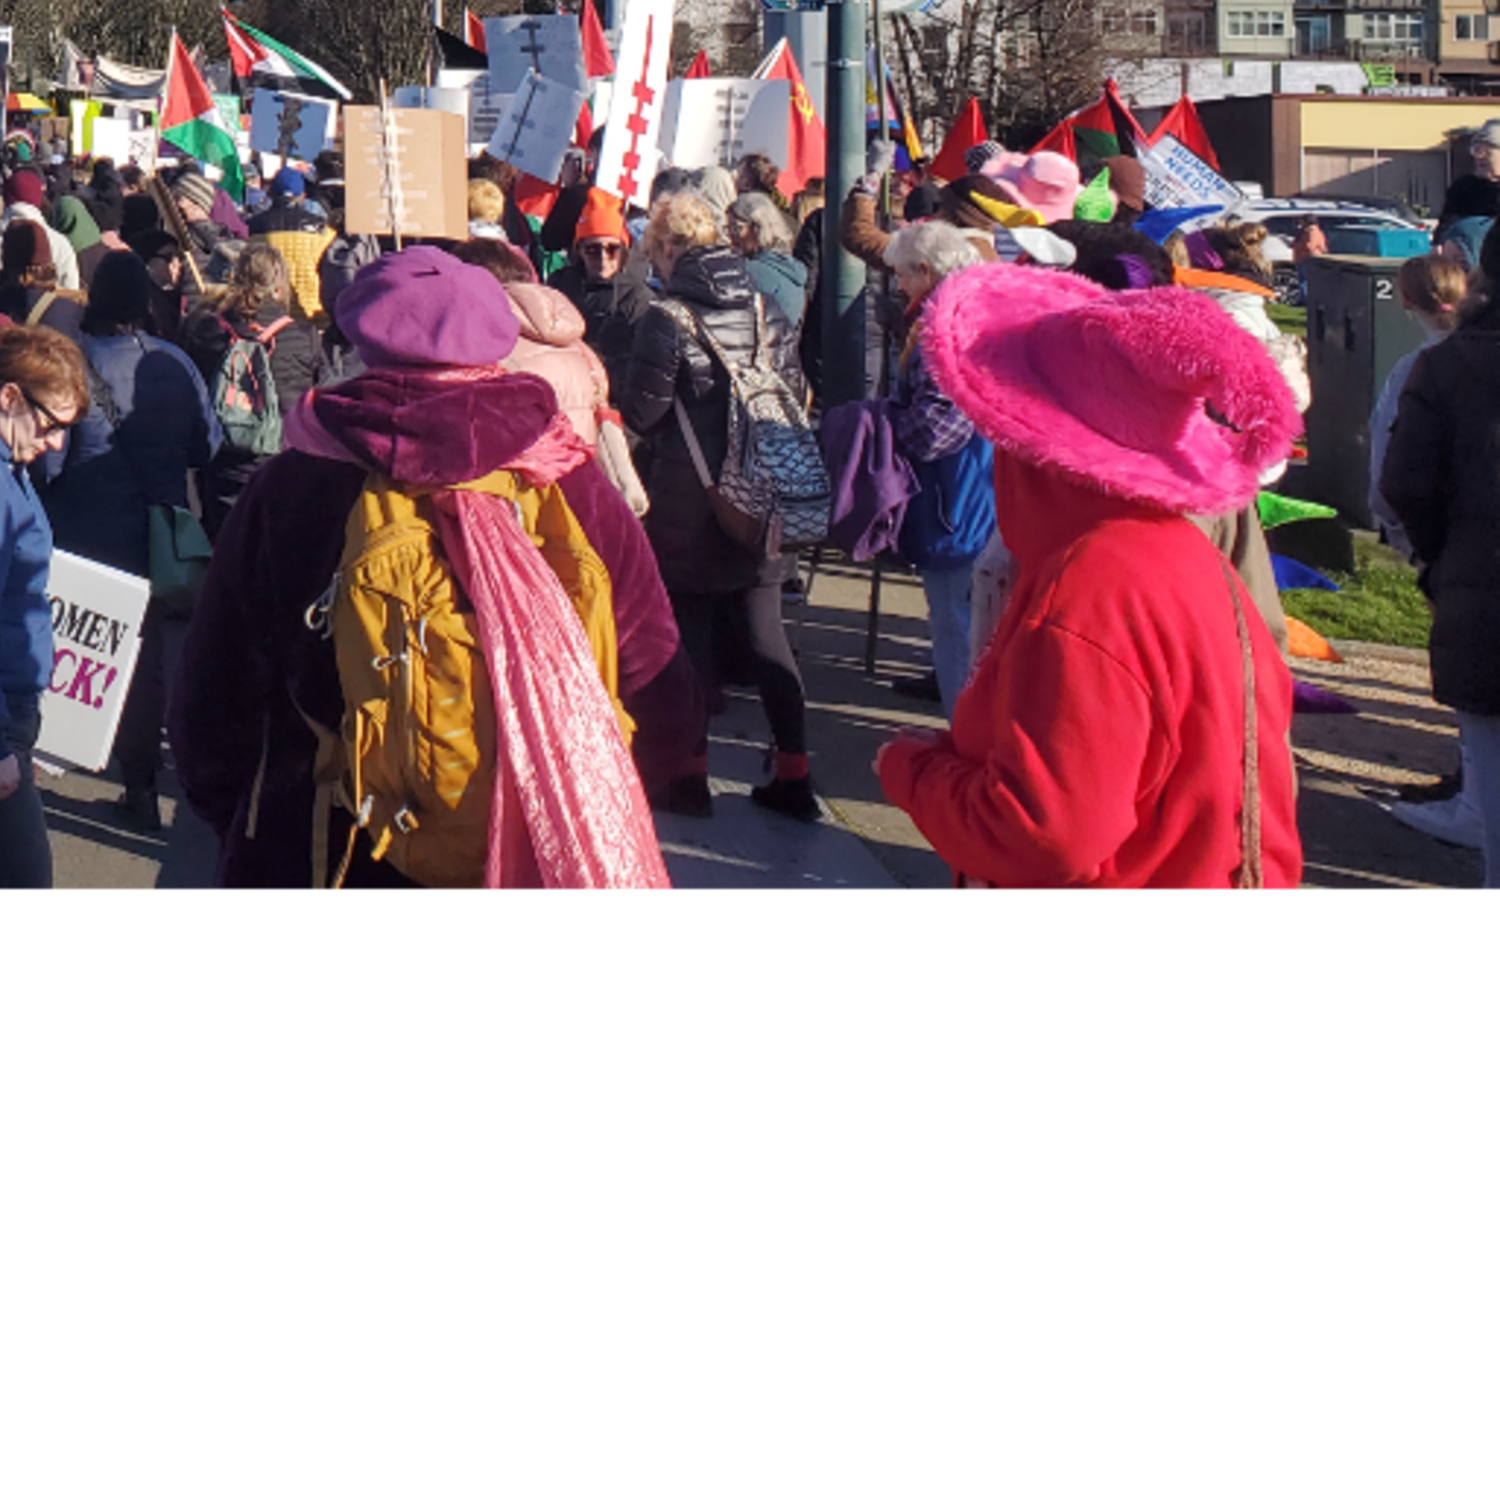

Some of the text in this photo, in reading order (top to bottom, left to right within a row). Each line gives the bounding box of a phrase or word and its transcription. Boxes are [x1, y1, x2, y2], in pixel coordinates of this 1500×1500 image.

[1165, 157, 1210, 199] NEEDS
[1171, 145, 1226, 190] HUMAN
[1376, 279, 1393, 299] 2
[49, 595, 129, 657] OMEN
[49, 648, 118, 710] CK!
